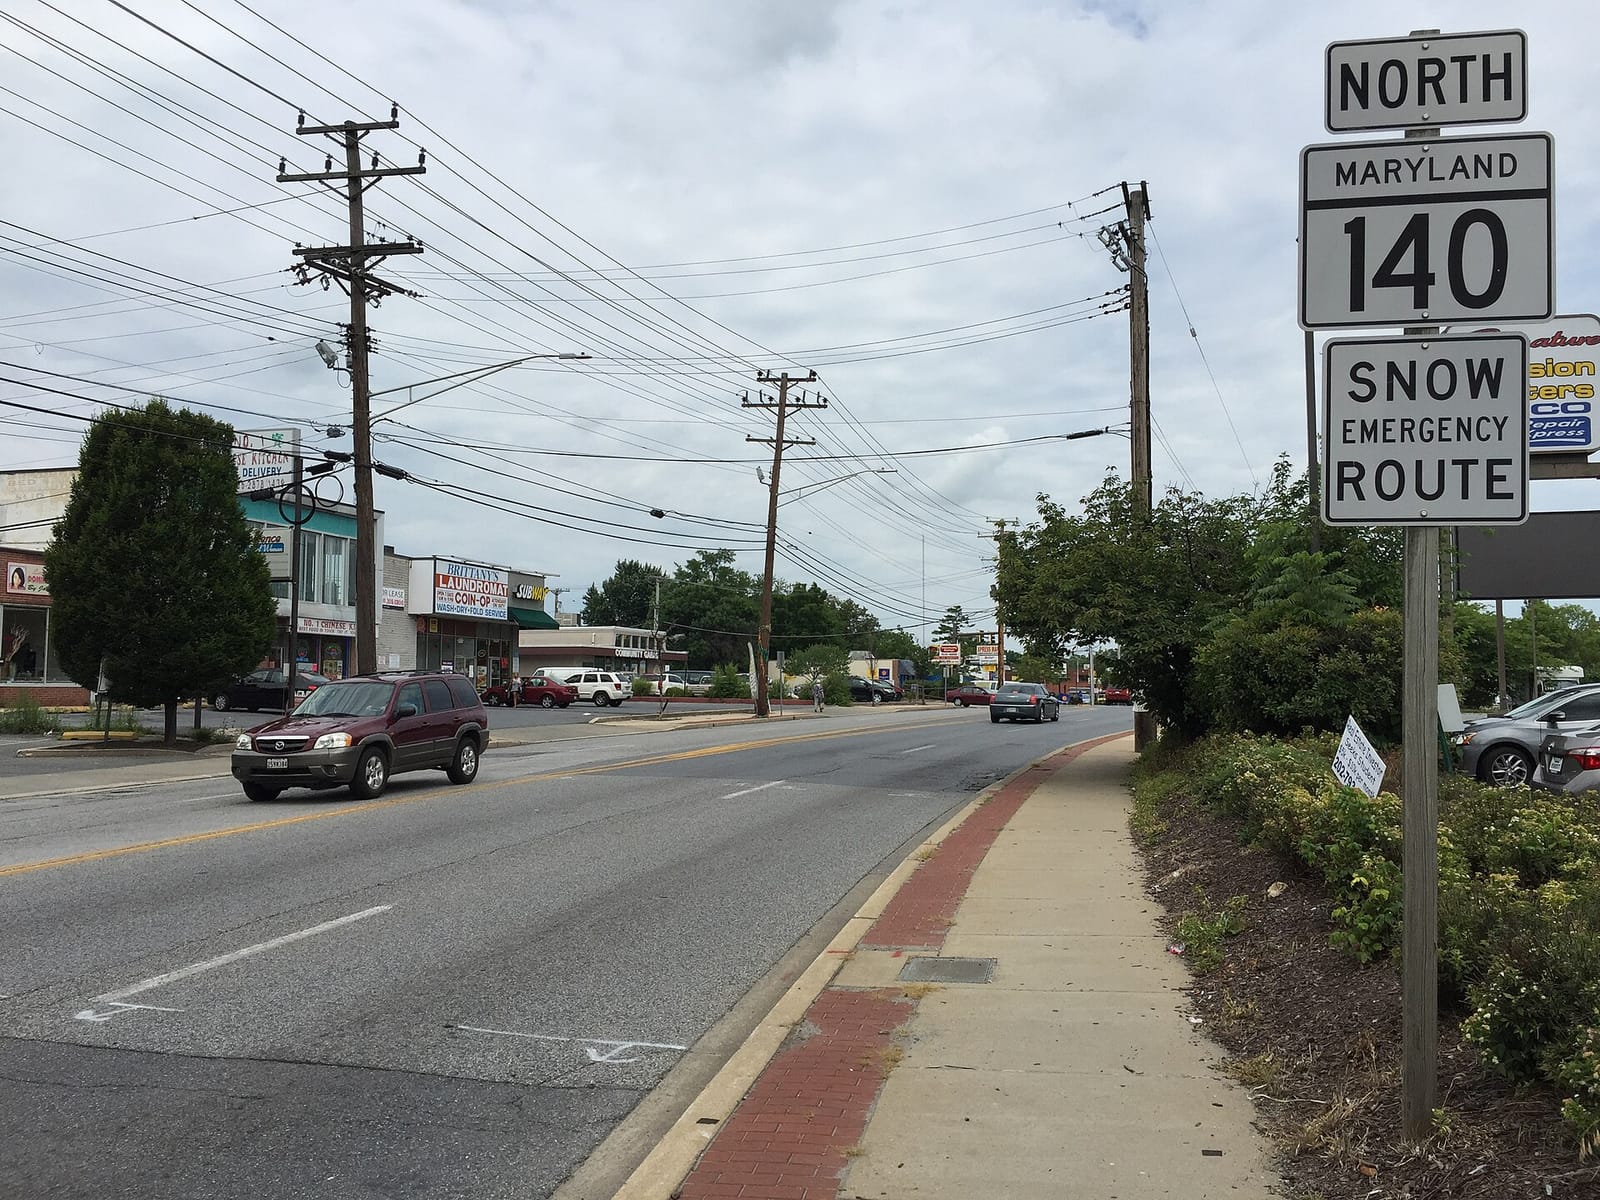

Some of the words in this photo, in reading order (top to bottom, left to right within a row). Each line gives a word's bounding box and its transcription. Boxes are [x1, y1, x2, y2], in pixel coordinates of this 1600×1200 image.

[1340, 52, 1512, 111] NORTH
[1335, 152, 1518, 187] MARYLAND
[1343, 207, 1509, 313] 140
[1347, 357, 1505, 403] SNOW
[1342, 415, 1509, 444] EMERGENCY
[242, 466, 282, 477] DELIVERY
[1336, 458, 1514, 502] ROUTE
[447, 563, 500, 582] BRITTANY'S
[439, 575, 508, 597] LAUNDROMAT
[517, 583, 548, 601] SUBWAY
[455, 592, 491, 608] COIN-OP
[485, 609, 506, 619] SERVICE
[321, 621, 347, 630] CHINESE
